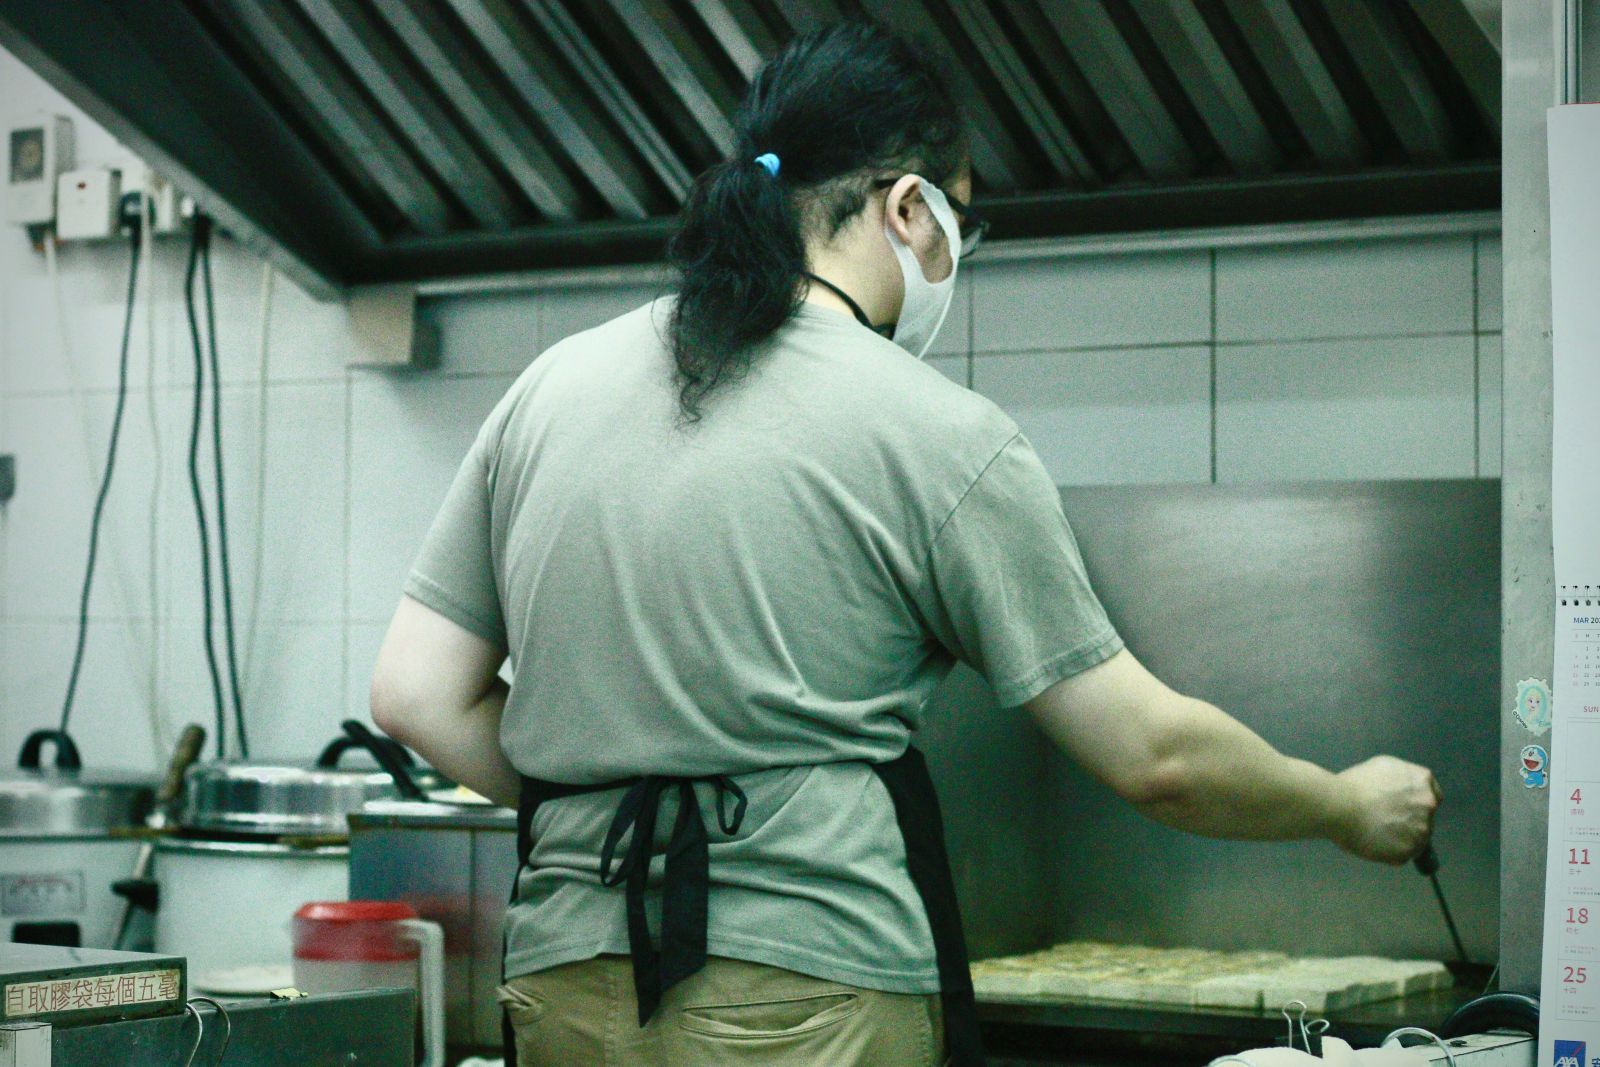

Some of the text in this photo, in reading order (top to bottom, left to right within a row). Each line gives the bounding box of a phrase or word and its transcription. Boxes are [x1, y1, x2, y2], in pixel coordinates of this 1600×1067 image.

[1573, 616, 1589, 624] MAR
[1583, 705, 1599, 713] SUN
[1570, 788, 1582, 805] 4
[1568, 848, 1591, 865] 11
[1566, 907, 1589, 924] 18
[1563, 966, 1587, 984] 25
[7, 973, 178, 1013] 自取膠袋每個五毫
